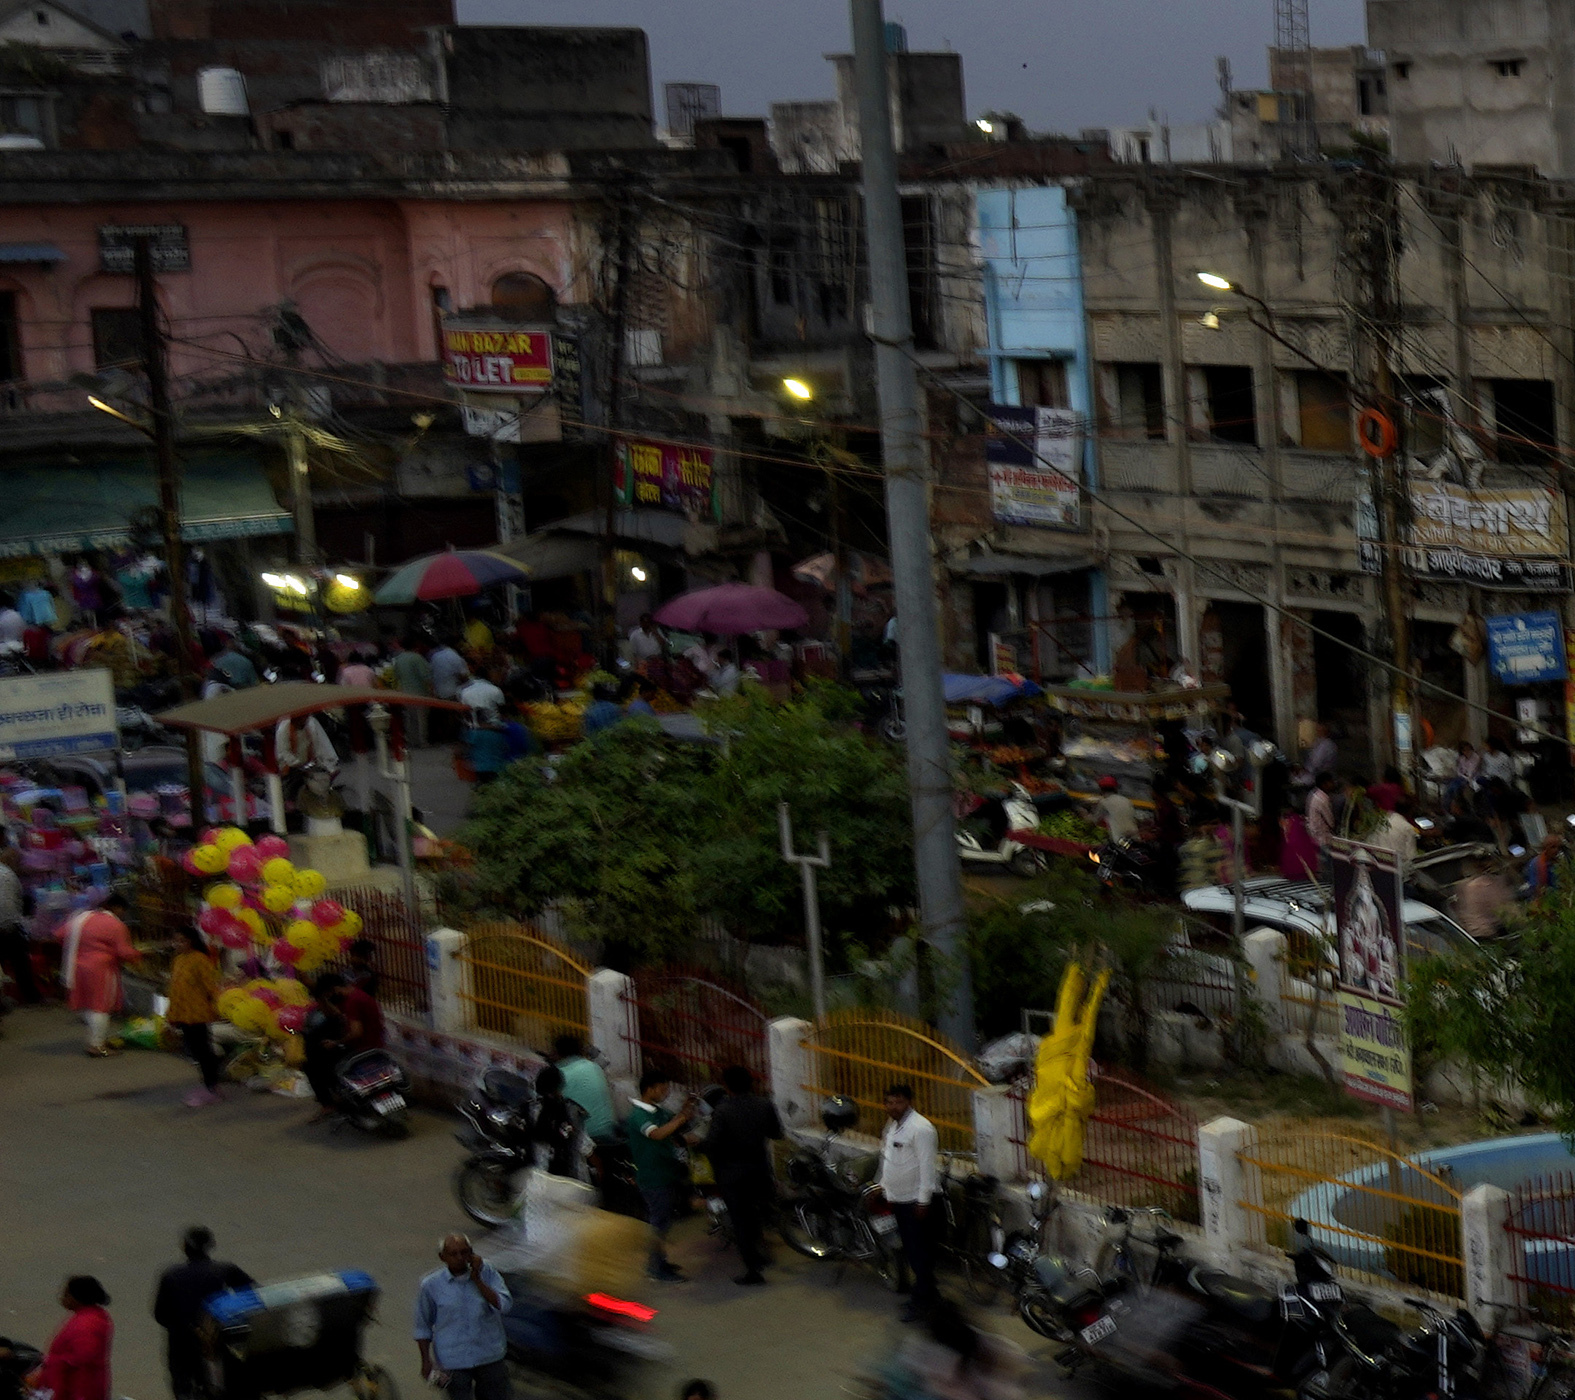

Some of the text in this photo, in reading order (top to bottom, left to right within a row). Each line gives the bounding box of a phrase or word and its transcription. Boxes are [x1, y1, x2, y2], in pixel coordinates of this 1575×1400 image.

[472, 333, 533, 355] BAZAR
[452, 355, 516, 383] TO LET
